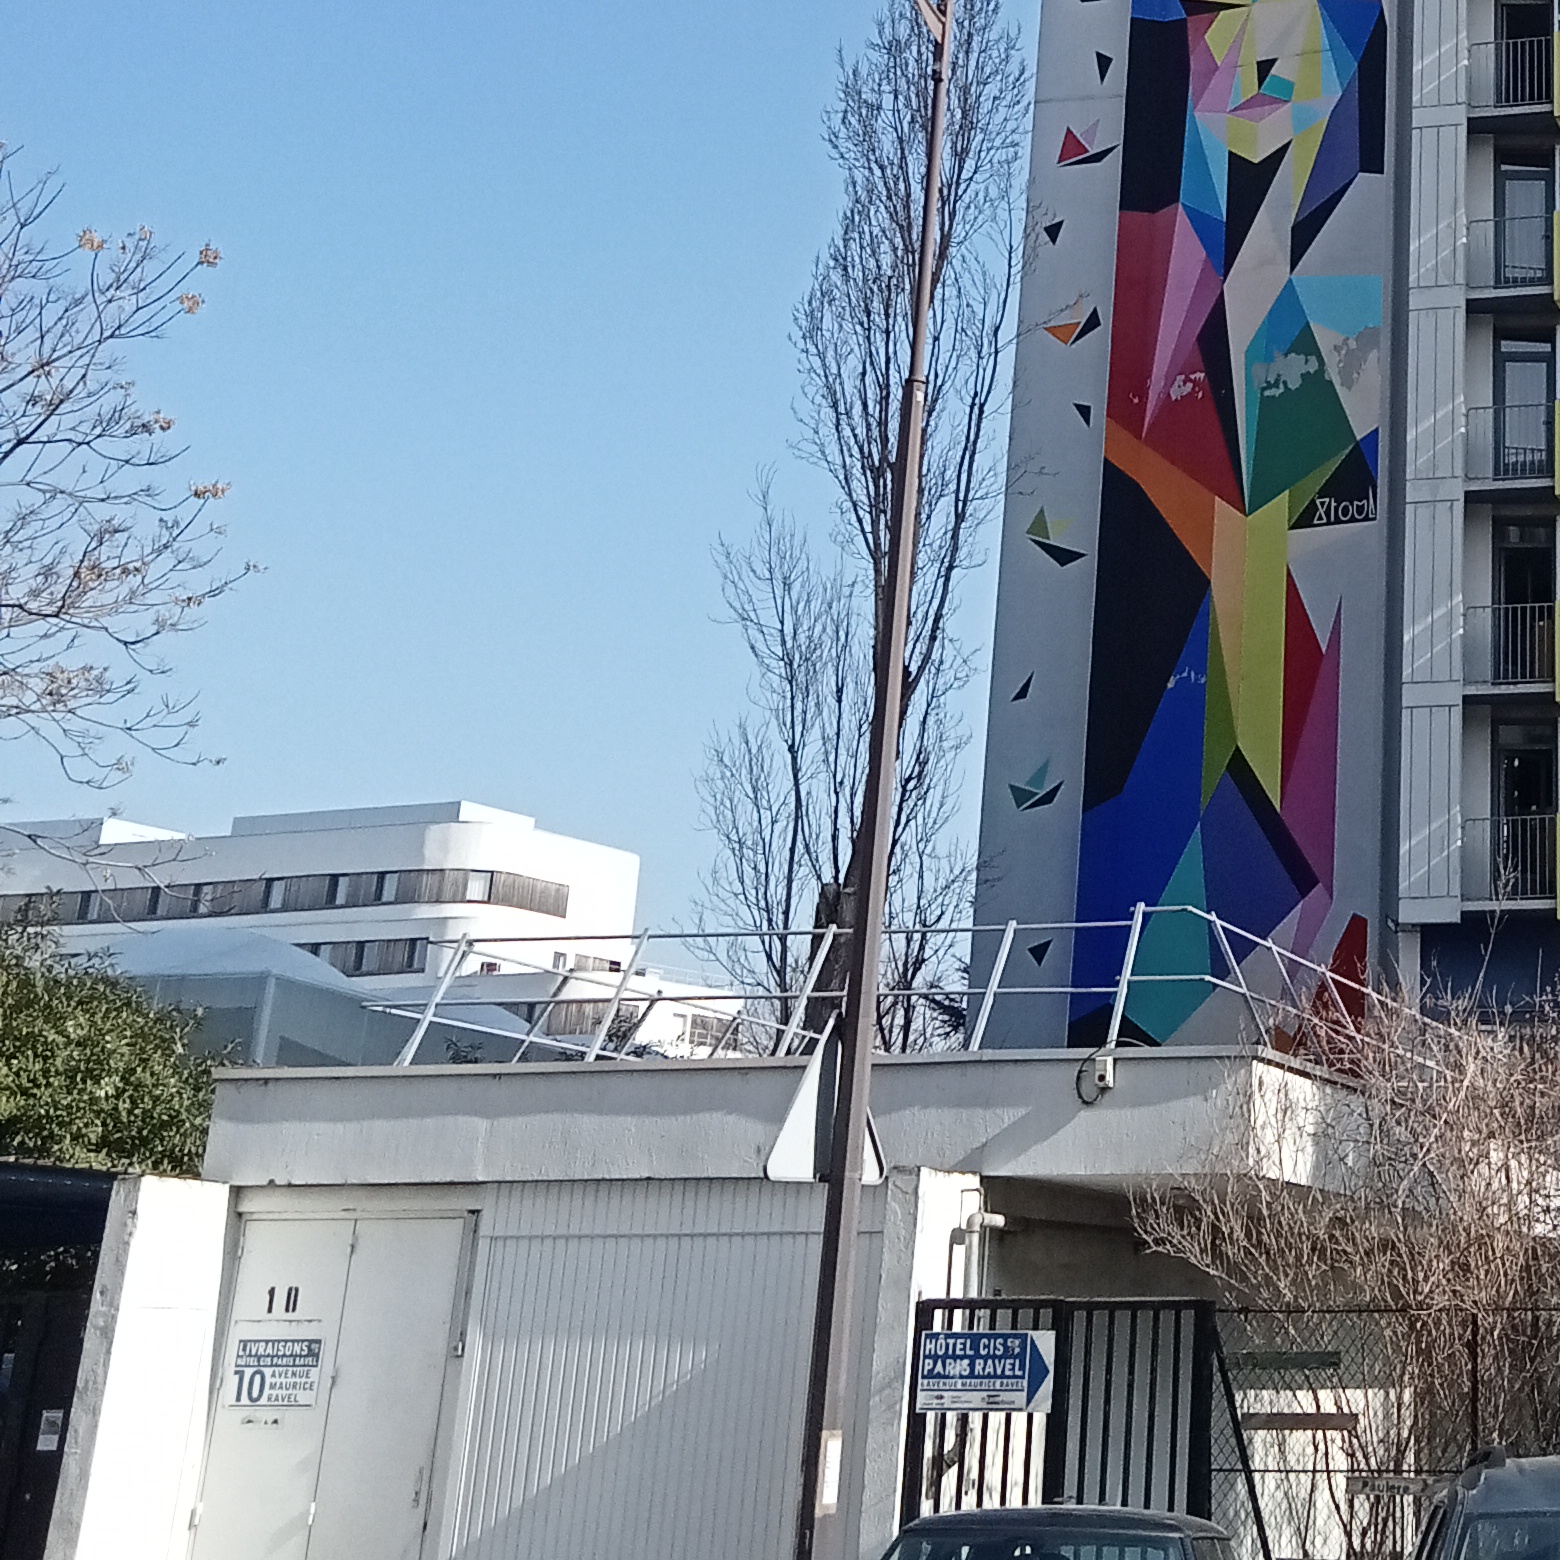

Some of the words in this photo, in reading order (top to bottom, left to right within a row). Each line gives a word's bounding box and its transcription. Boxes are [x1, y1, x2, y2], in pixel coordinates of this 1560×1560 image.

[238, 1341, 309, 1356] LIVRAISONS
[924, 1334, 975, 1356] HÔTEL
[980, 1338, 1004, 1356] CIS
[272, 1356, 294, 1366] PARIS
[294, 1356, 318, 1366] RAVEL
[923, 1358, 971, 1376] PARIS
[974, 1358, 1024, 1376] RAVEL
[270, 1368, 312, 1380] AVENUE
[233, 1368, 267, 1404] 10
[268, 1380, 316, 1391] MAURICE
[926, 1380, 959, 1388] AVENUE
[960, 1380, 998, 1388] MAURICE
[999, 1380, 1025, 1388] RAVEL
[266, 1392, 300, 1403] RAVEL
